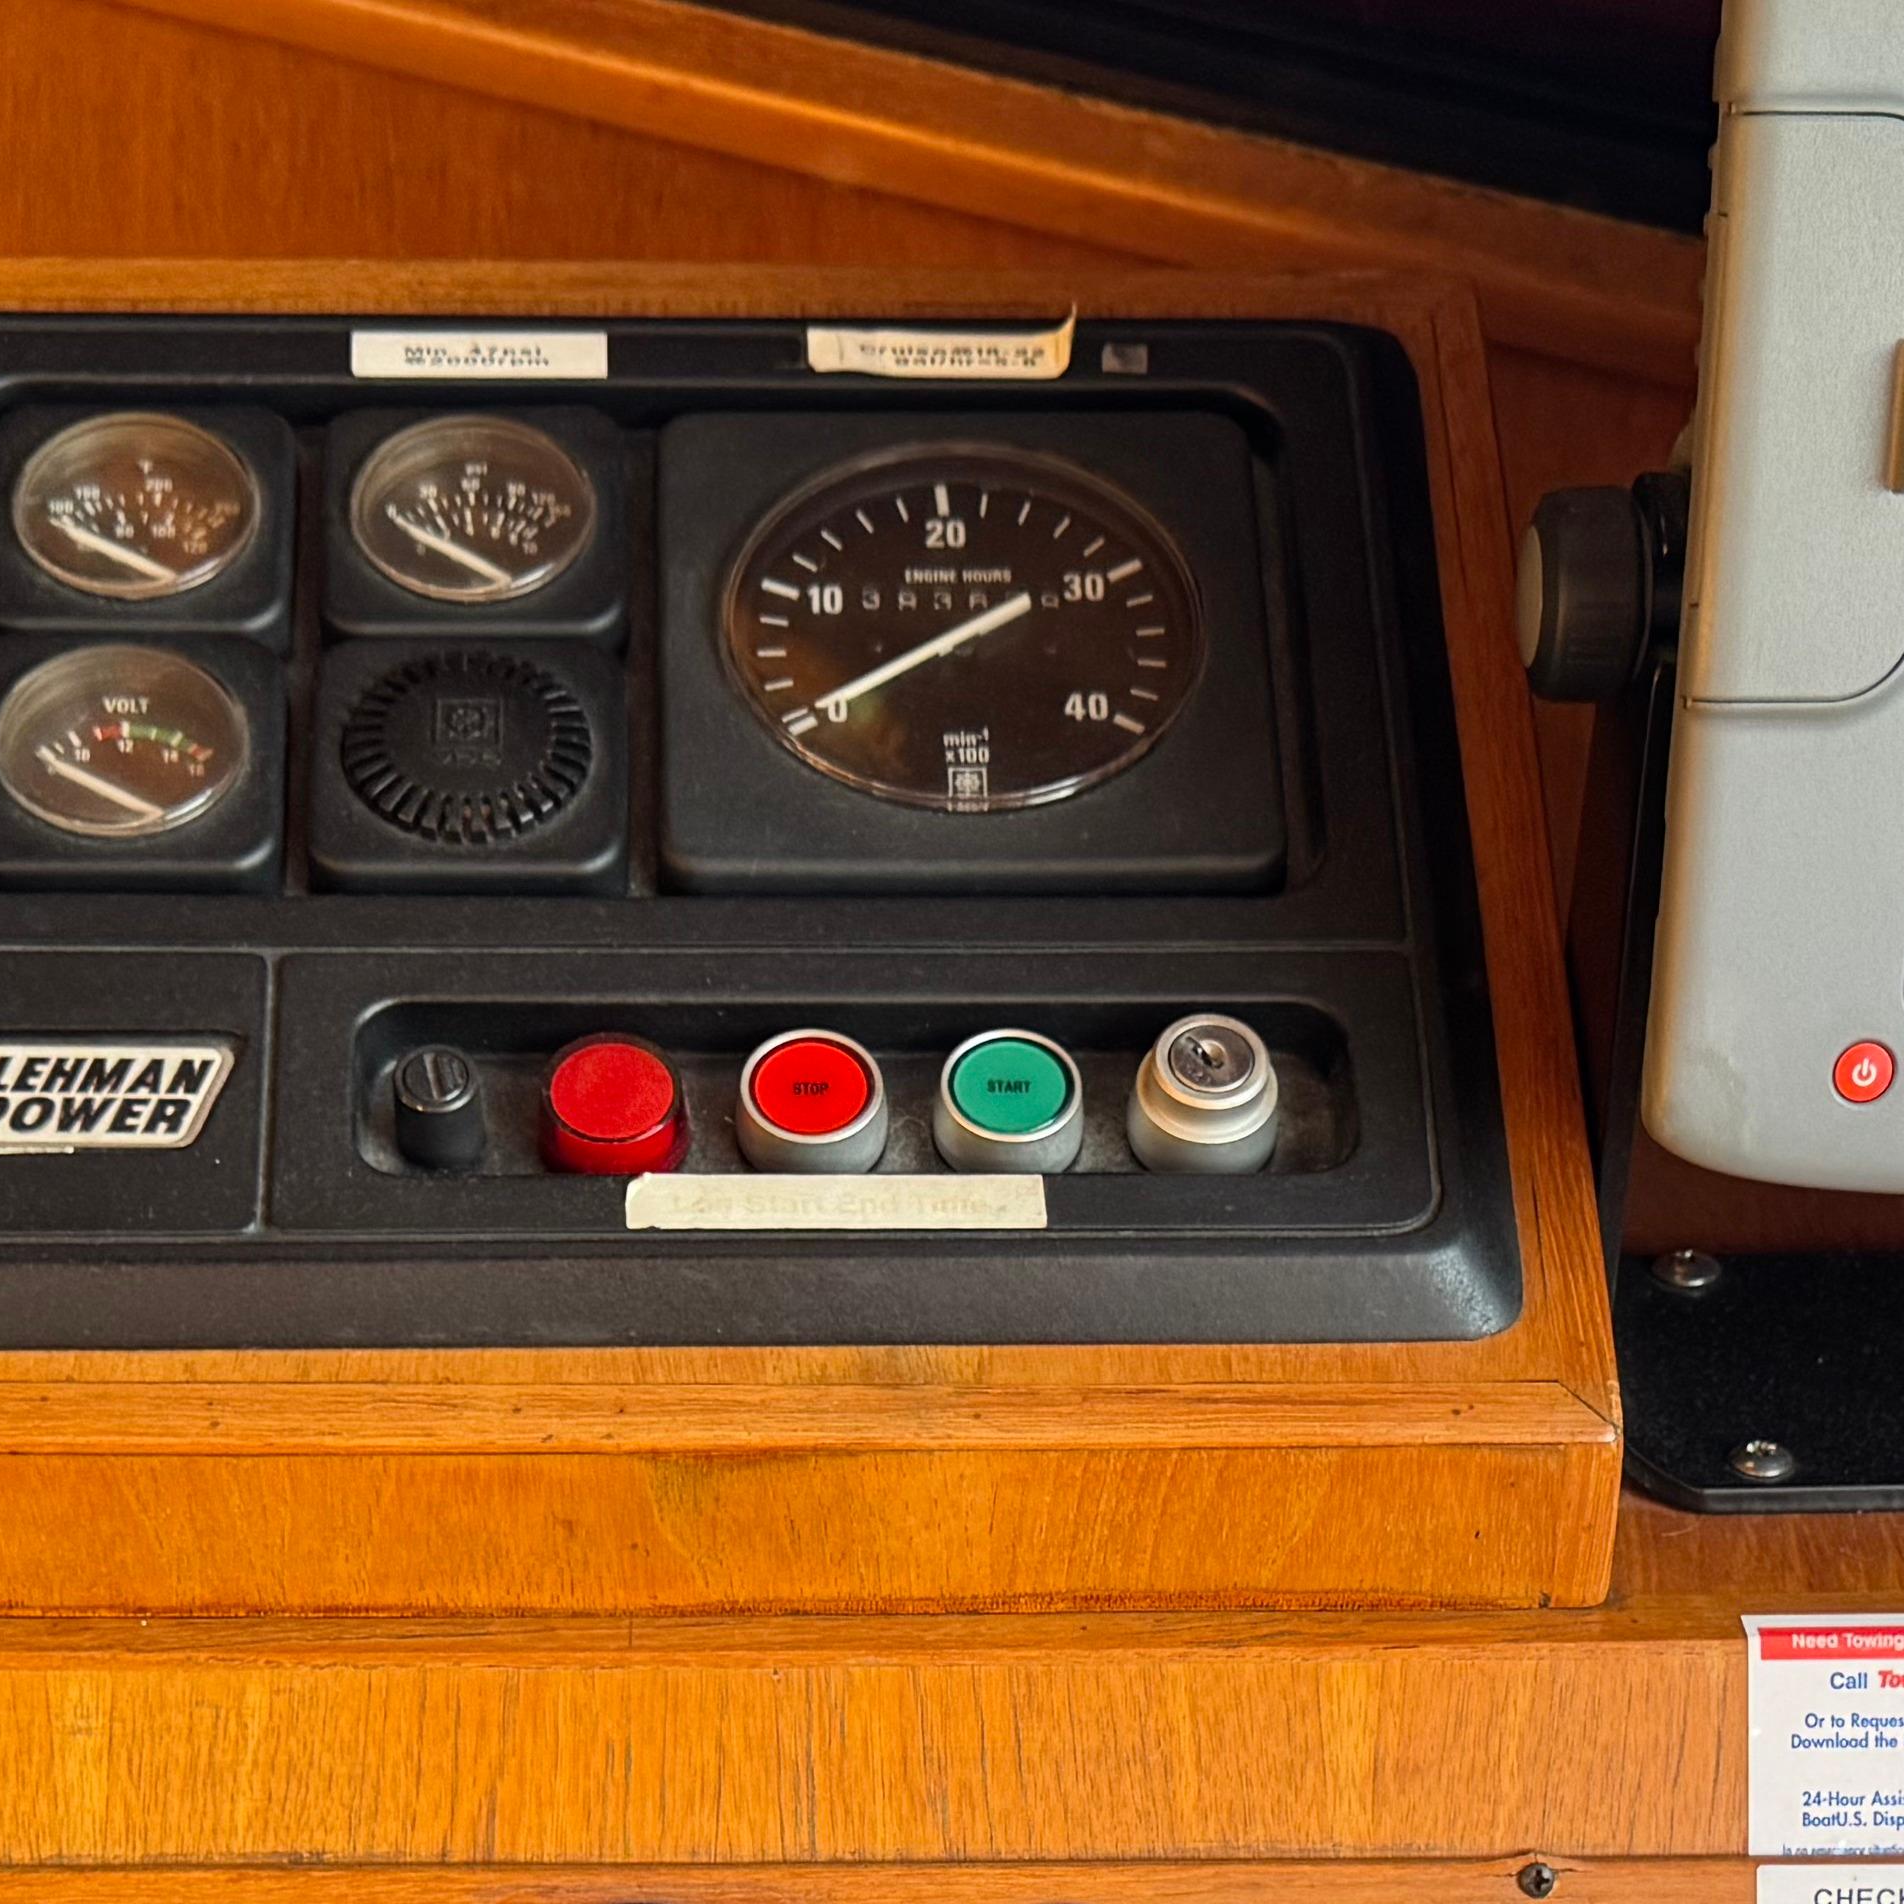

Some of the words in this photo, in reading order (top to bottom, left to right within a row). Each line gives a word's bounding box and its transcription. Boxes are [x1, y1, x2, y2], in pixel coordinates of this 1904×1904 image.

[925, 520, 966, 549] 20
[905, 569, 956, 585] ENGINE
[962, 569, 1012, 585] HOURS
[1063, 573, 1105, 603] 30
[808, 585, 844, 617] 10
[102, 697, 148, 714] VOLT
[1064, 693, 1109, 722] 40
[793, 1082, 829, 1096] STOP
[987, 1080, 1031, 1094] START
[1830, 1672, 1868, 1690] Call
[1804, 1713, 1825, 1728] Or
[1831, 1713, 1846, 1728] to
